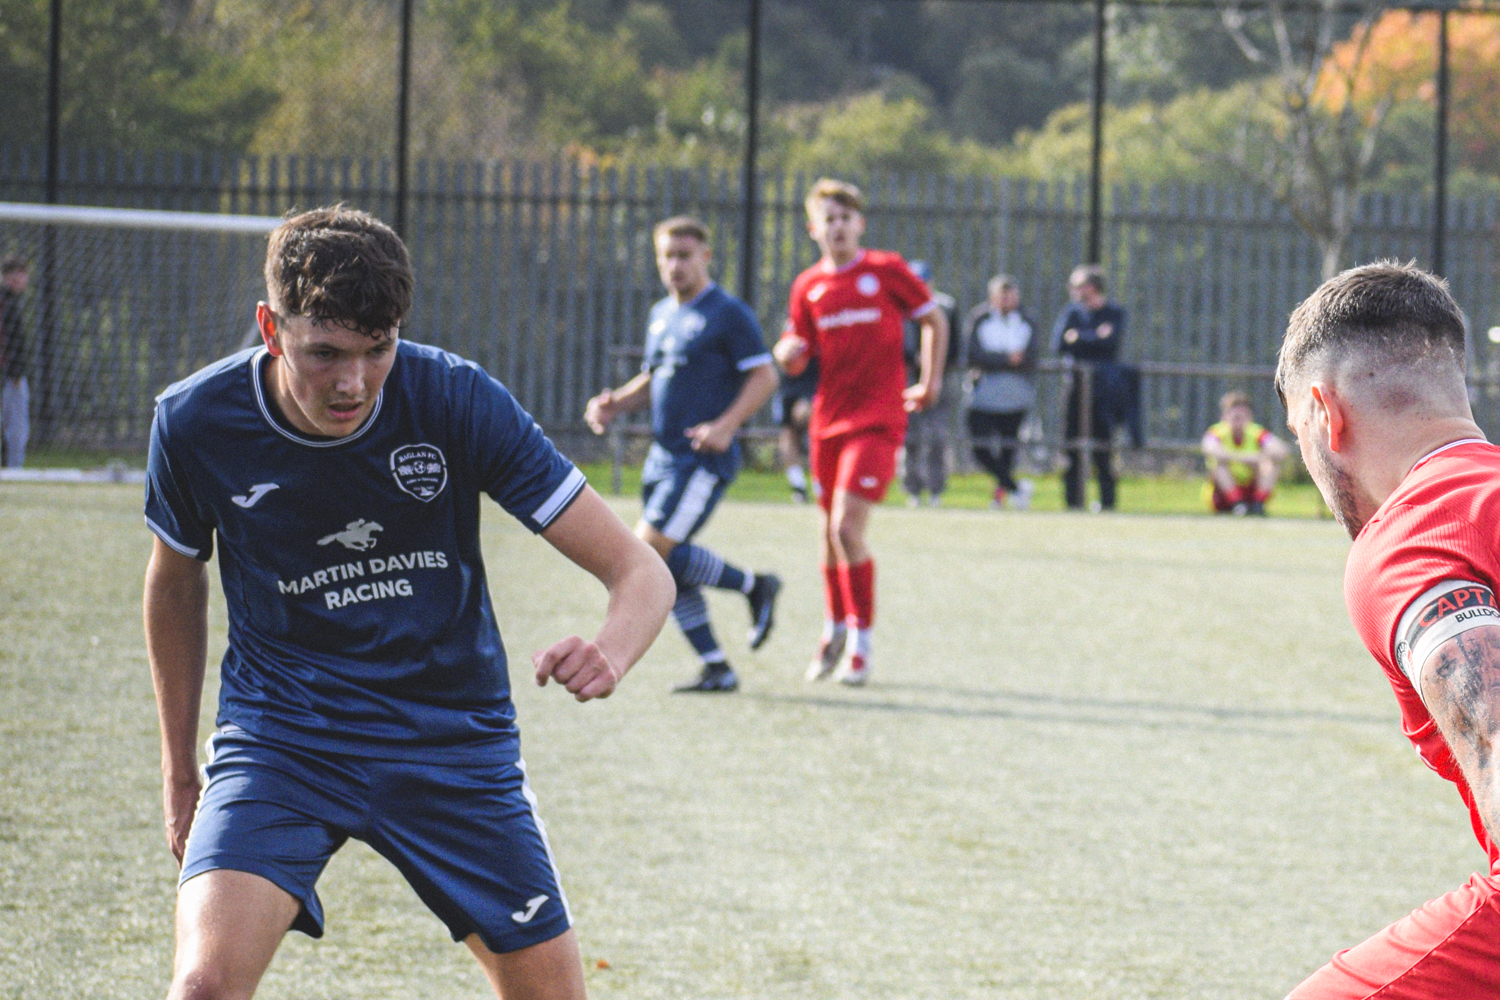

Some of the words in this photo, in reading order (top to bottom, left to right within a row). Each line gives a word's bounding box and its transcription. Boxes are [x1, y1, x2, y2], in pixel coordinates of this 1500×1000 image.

[427, 452, 437, 460] FC
[277, 561, 365, 595] MARTIN
[368, 551, 449, 574] DAVIES
[324, 578, 414, 610] RACING
